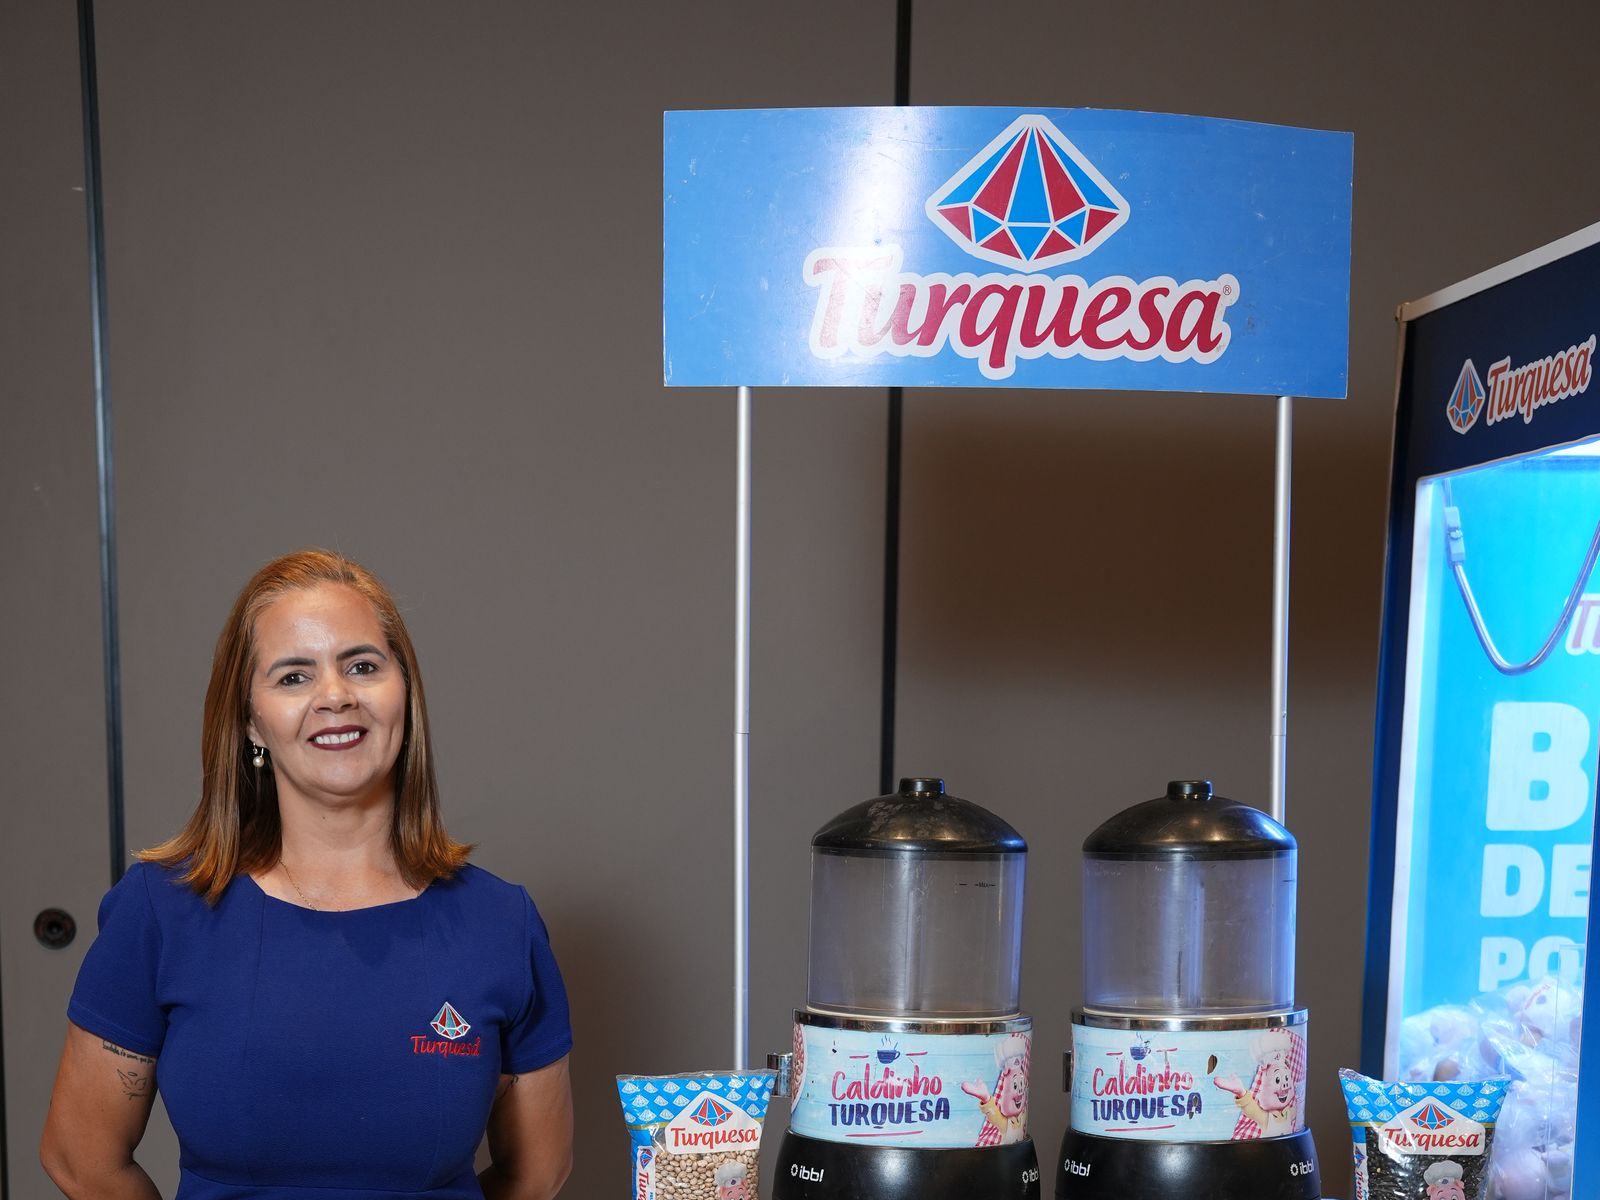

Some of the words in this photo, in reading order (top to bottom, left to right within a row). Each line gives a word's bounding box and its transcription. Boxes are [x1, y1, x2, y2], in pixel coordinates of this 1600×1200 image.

[1488, 345, 1593, 421] Turquesa
[411, 1035, 480, 1057] Turquesa
[832, 1063, 942, 1101] Caldinho
[1093, 1060, 1193, 1097] Caldinho
[828, 1097, 950, 1129] TURQUESA
[1091, 1092, 1202, 1124] TURQUESA
[671, 1127, 759, 1149] Turquesa
[1384, 1128, 1480, 1151] Turquesa
